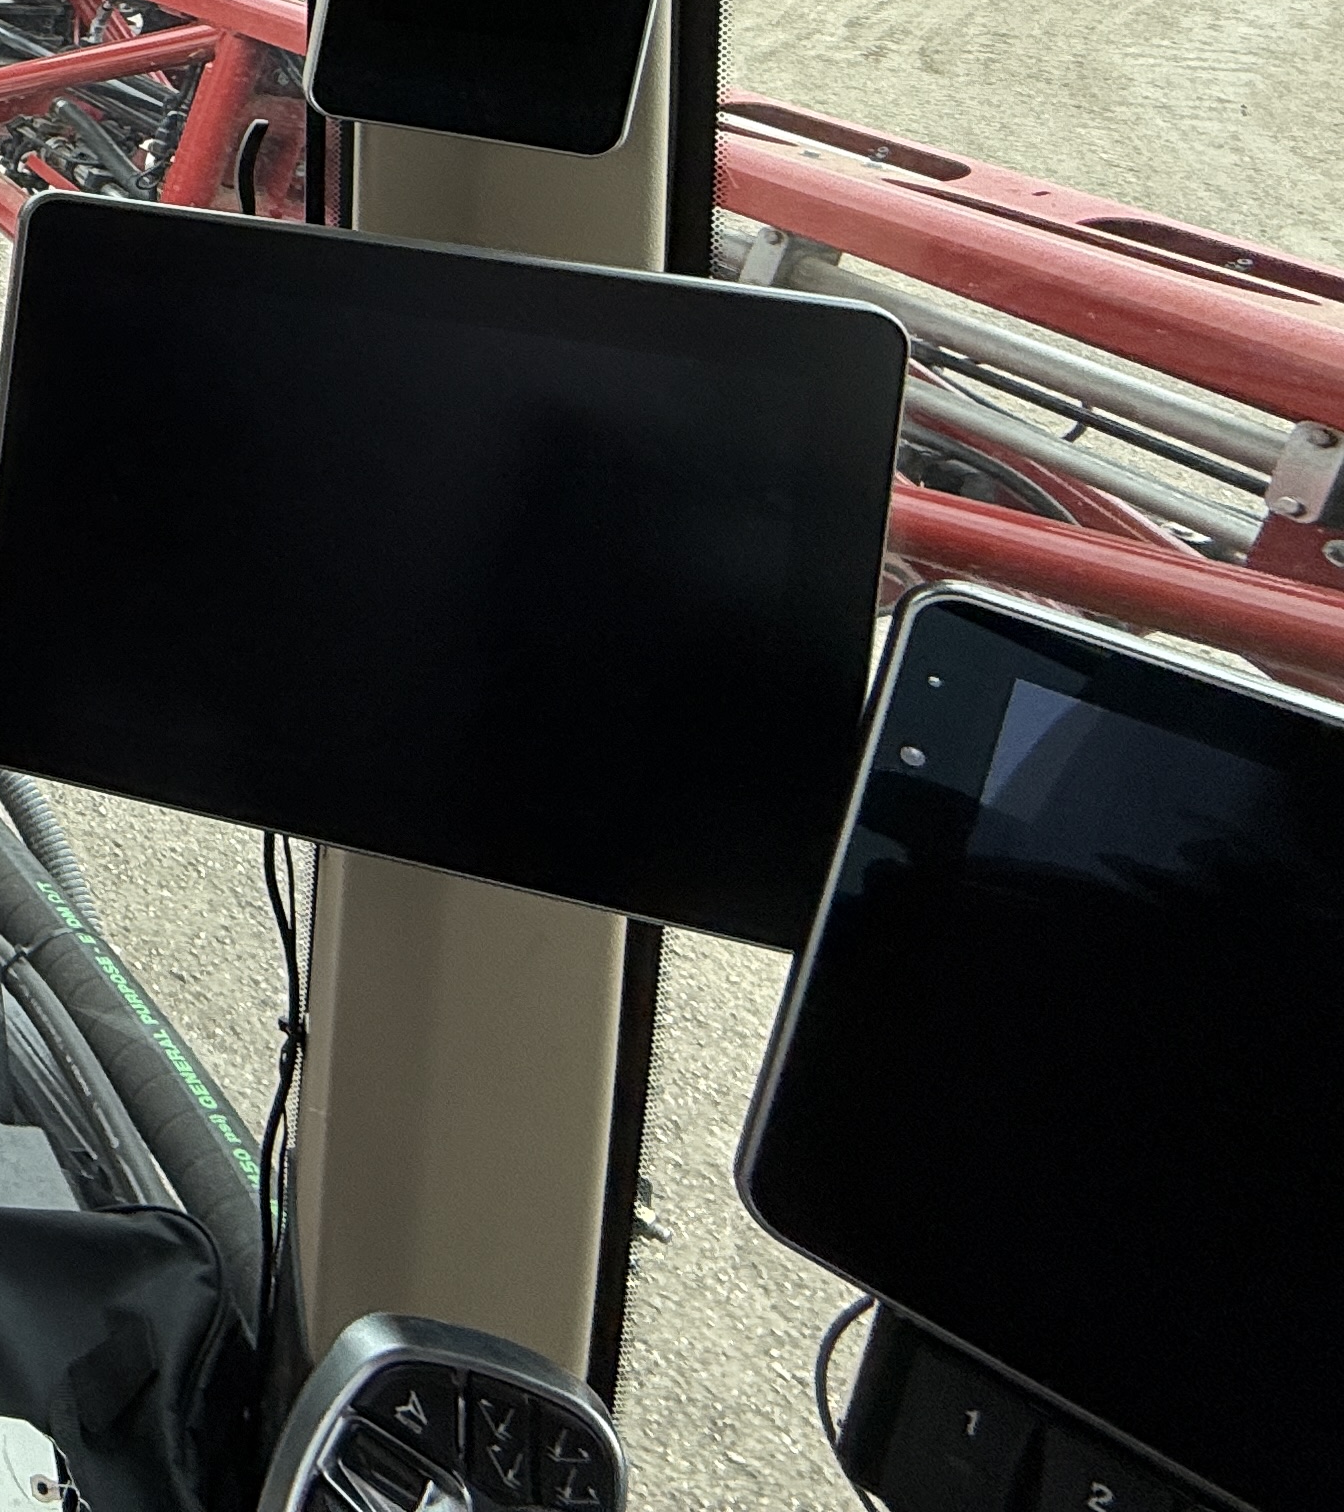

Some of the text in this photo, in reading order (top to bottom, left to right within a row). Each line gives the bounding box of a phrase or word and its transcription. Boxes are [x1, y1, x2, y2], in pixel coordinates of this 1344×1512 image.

[94, 955, 160, 1027] PURPOSE
[153, 1029, 218, 1110] GENERAL
[964, 1409, 980, 1436] 1
[1087, 1481, 1115, 1512] 2
